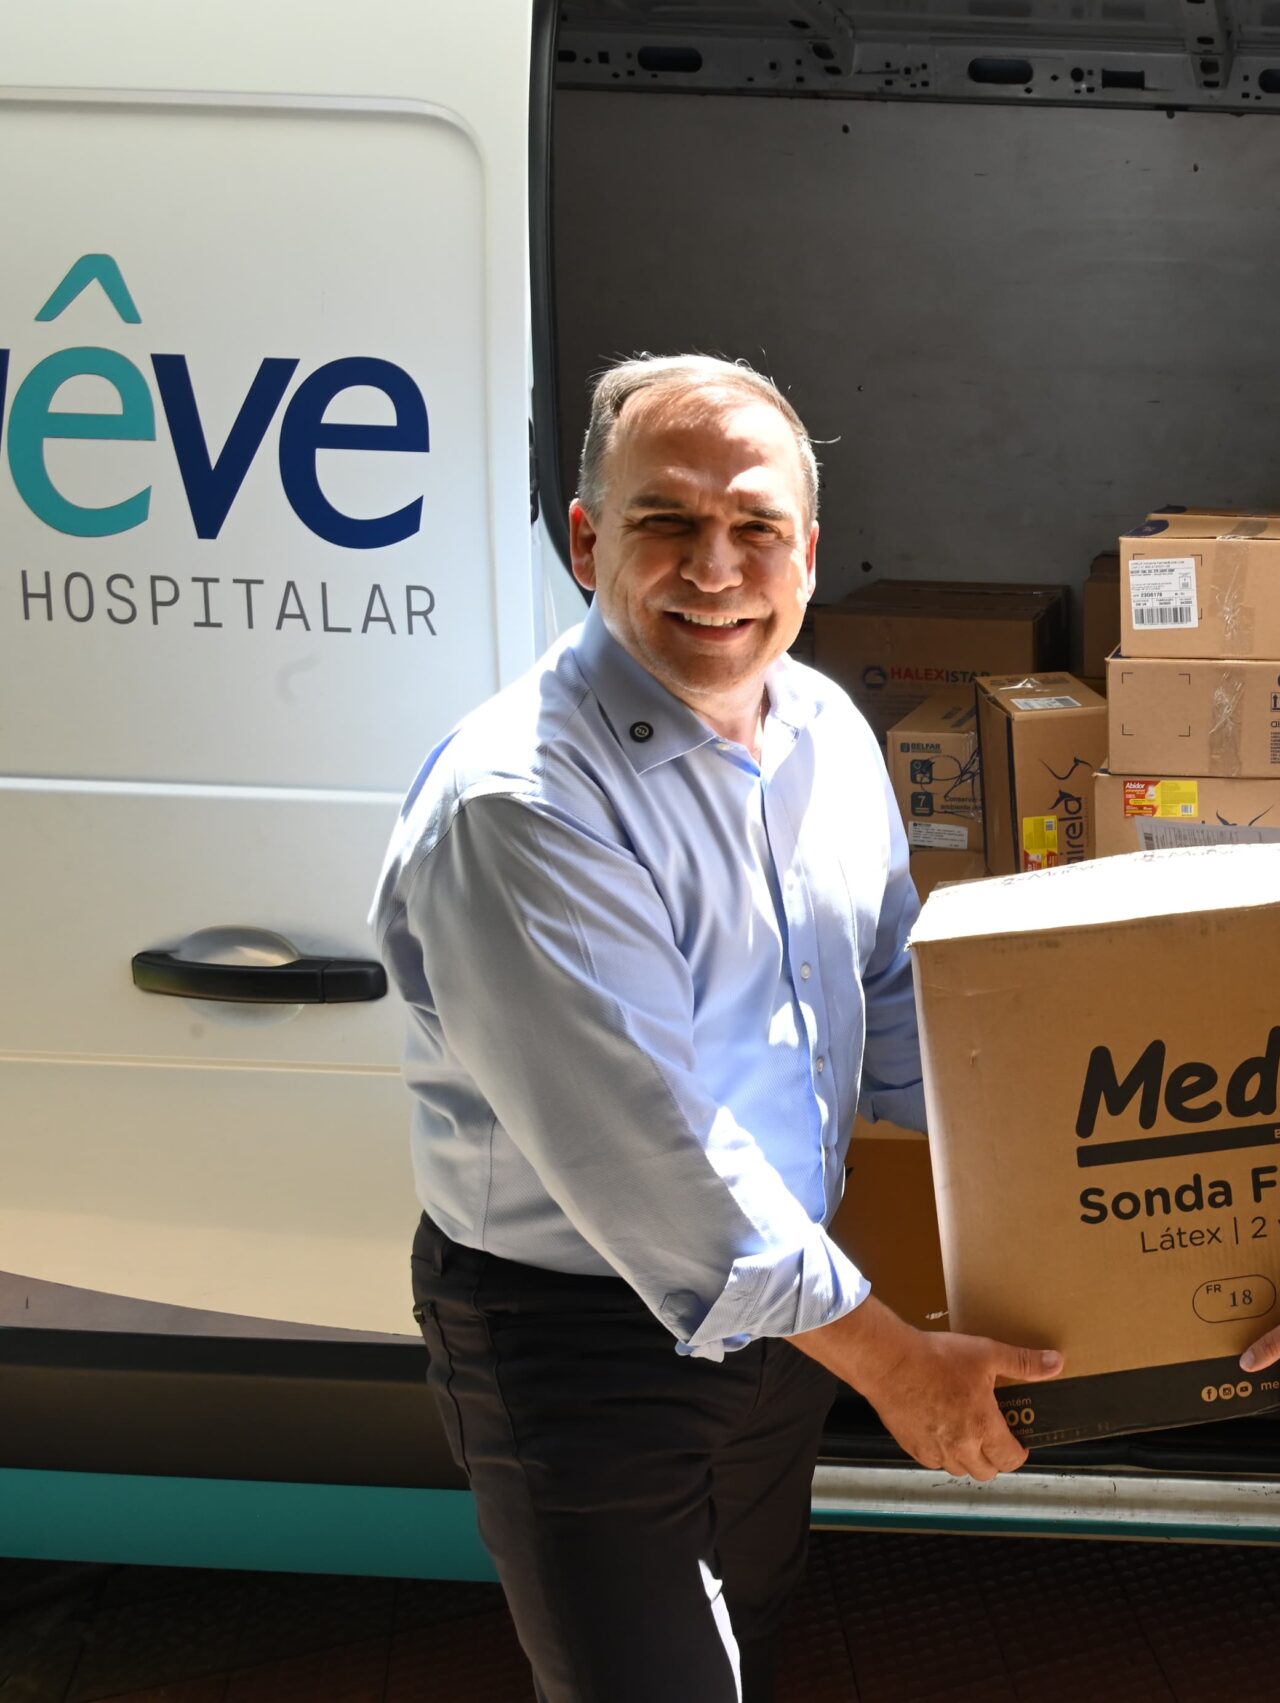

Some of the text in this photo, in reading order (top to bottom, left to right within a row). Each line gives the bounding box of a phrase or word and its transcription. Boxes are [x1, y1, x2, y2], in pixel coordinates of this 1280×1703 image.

[0, 253, 429, 549] êve
[21, 569, 438, 636] HOSPITALAR
[1125, 781, 1145, 790] Abidor
[1080, 1173, 1233, 1224] Sonda
[1140, 1226, 1222, 1253] Látex
[1251, 1216, 1267, 1239] 2
[1206, 1284, 1253, 1307] FR 18
[1005, 1407, 1035, 1426] 00
